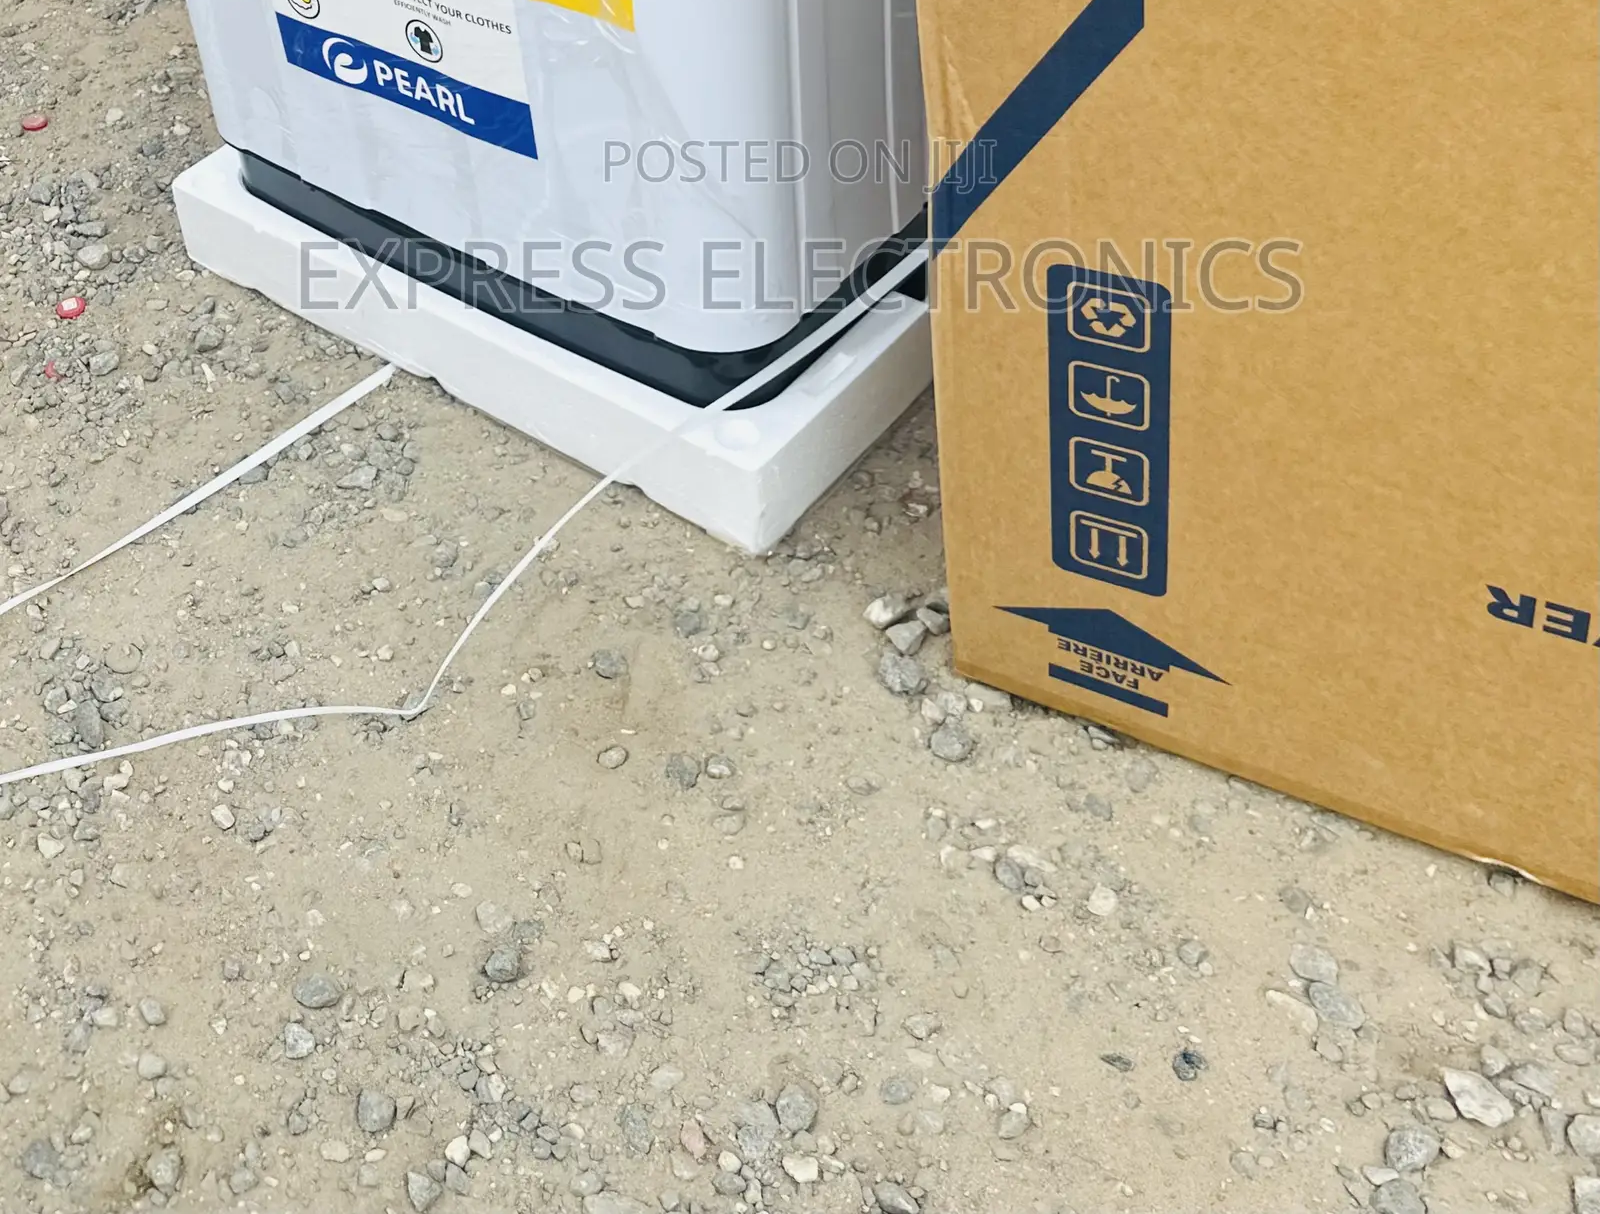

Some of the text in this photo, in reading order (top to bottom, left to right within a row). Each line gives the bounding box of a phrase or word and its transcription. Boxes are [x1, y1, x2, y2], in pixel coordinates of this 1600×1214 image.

[434, 2, 463, 19] YOUR
[464, 13, 512, 35] CLOTHES
[373, 59, 475, 125] PEARL
[1485, 584, 1600, 648] ER
[1080, 659, 1139, 690] FACE
